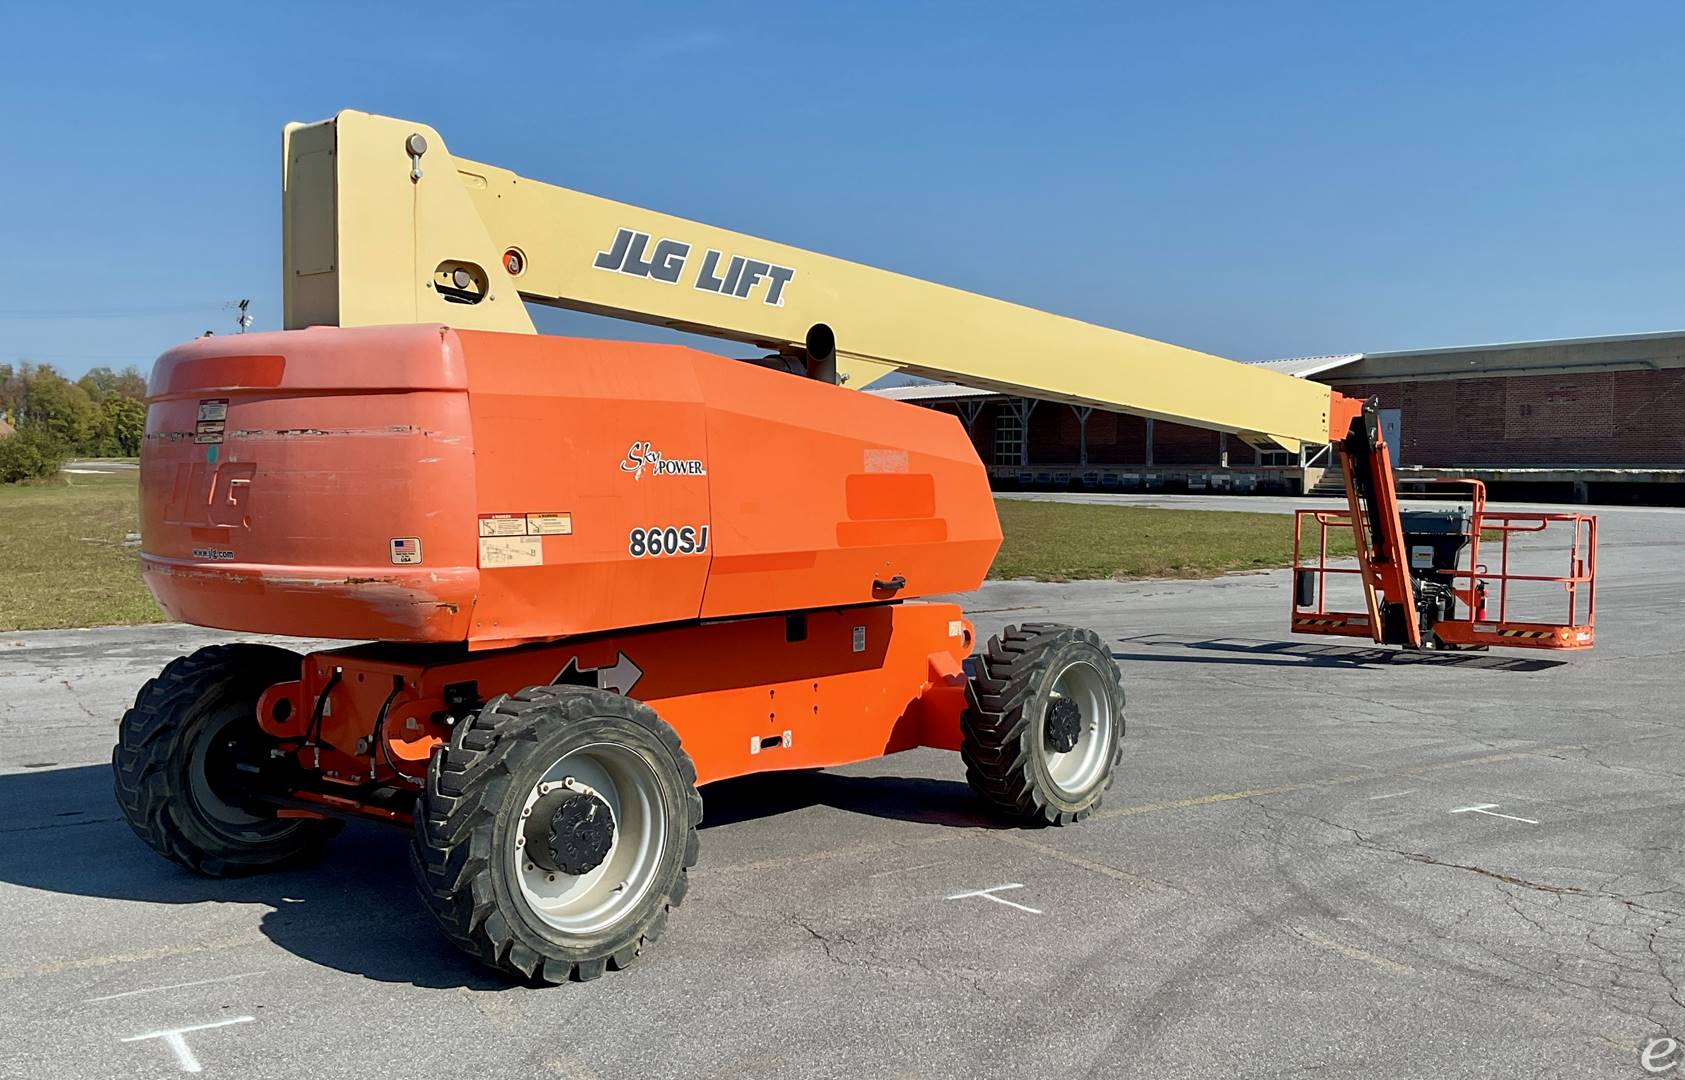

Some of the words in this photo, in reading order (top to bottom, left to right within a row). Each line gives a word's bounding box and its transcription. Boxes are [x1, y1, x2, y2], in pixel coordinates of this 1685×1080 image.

[592, 227, 692, 285] JLG
[693, 248, 796, 306] LIFT
[620, 441, 661, 476] Sky
[659, 460, 702, 475] POWER
[629, 526, 709, 557] 860SJ
